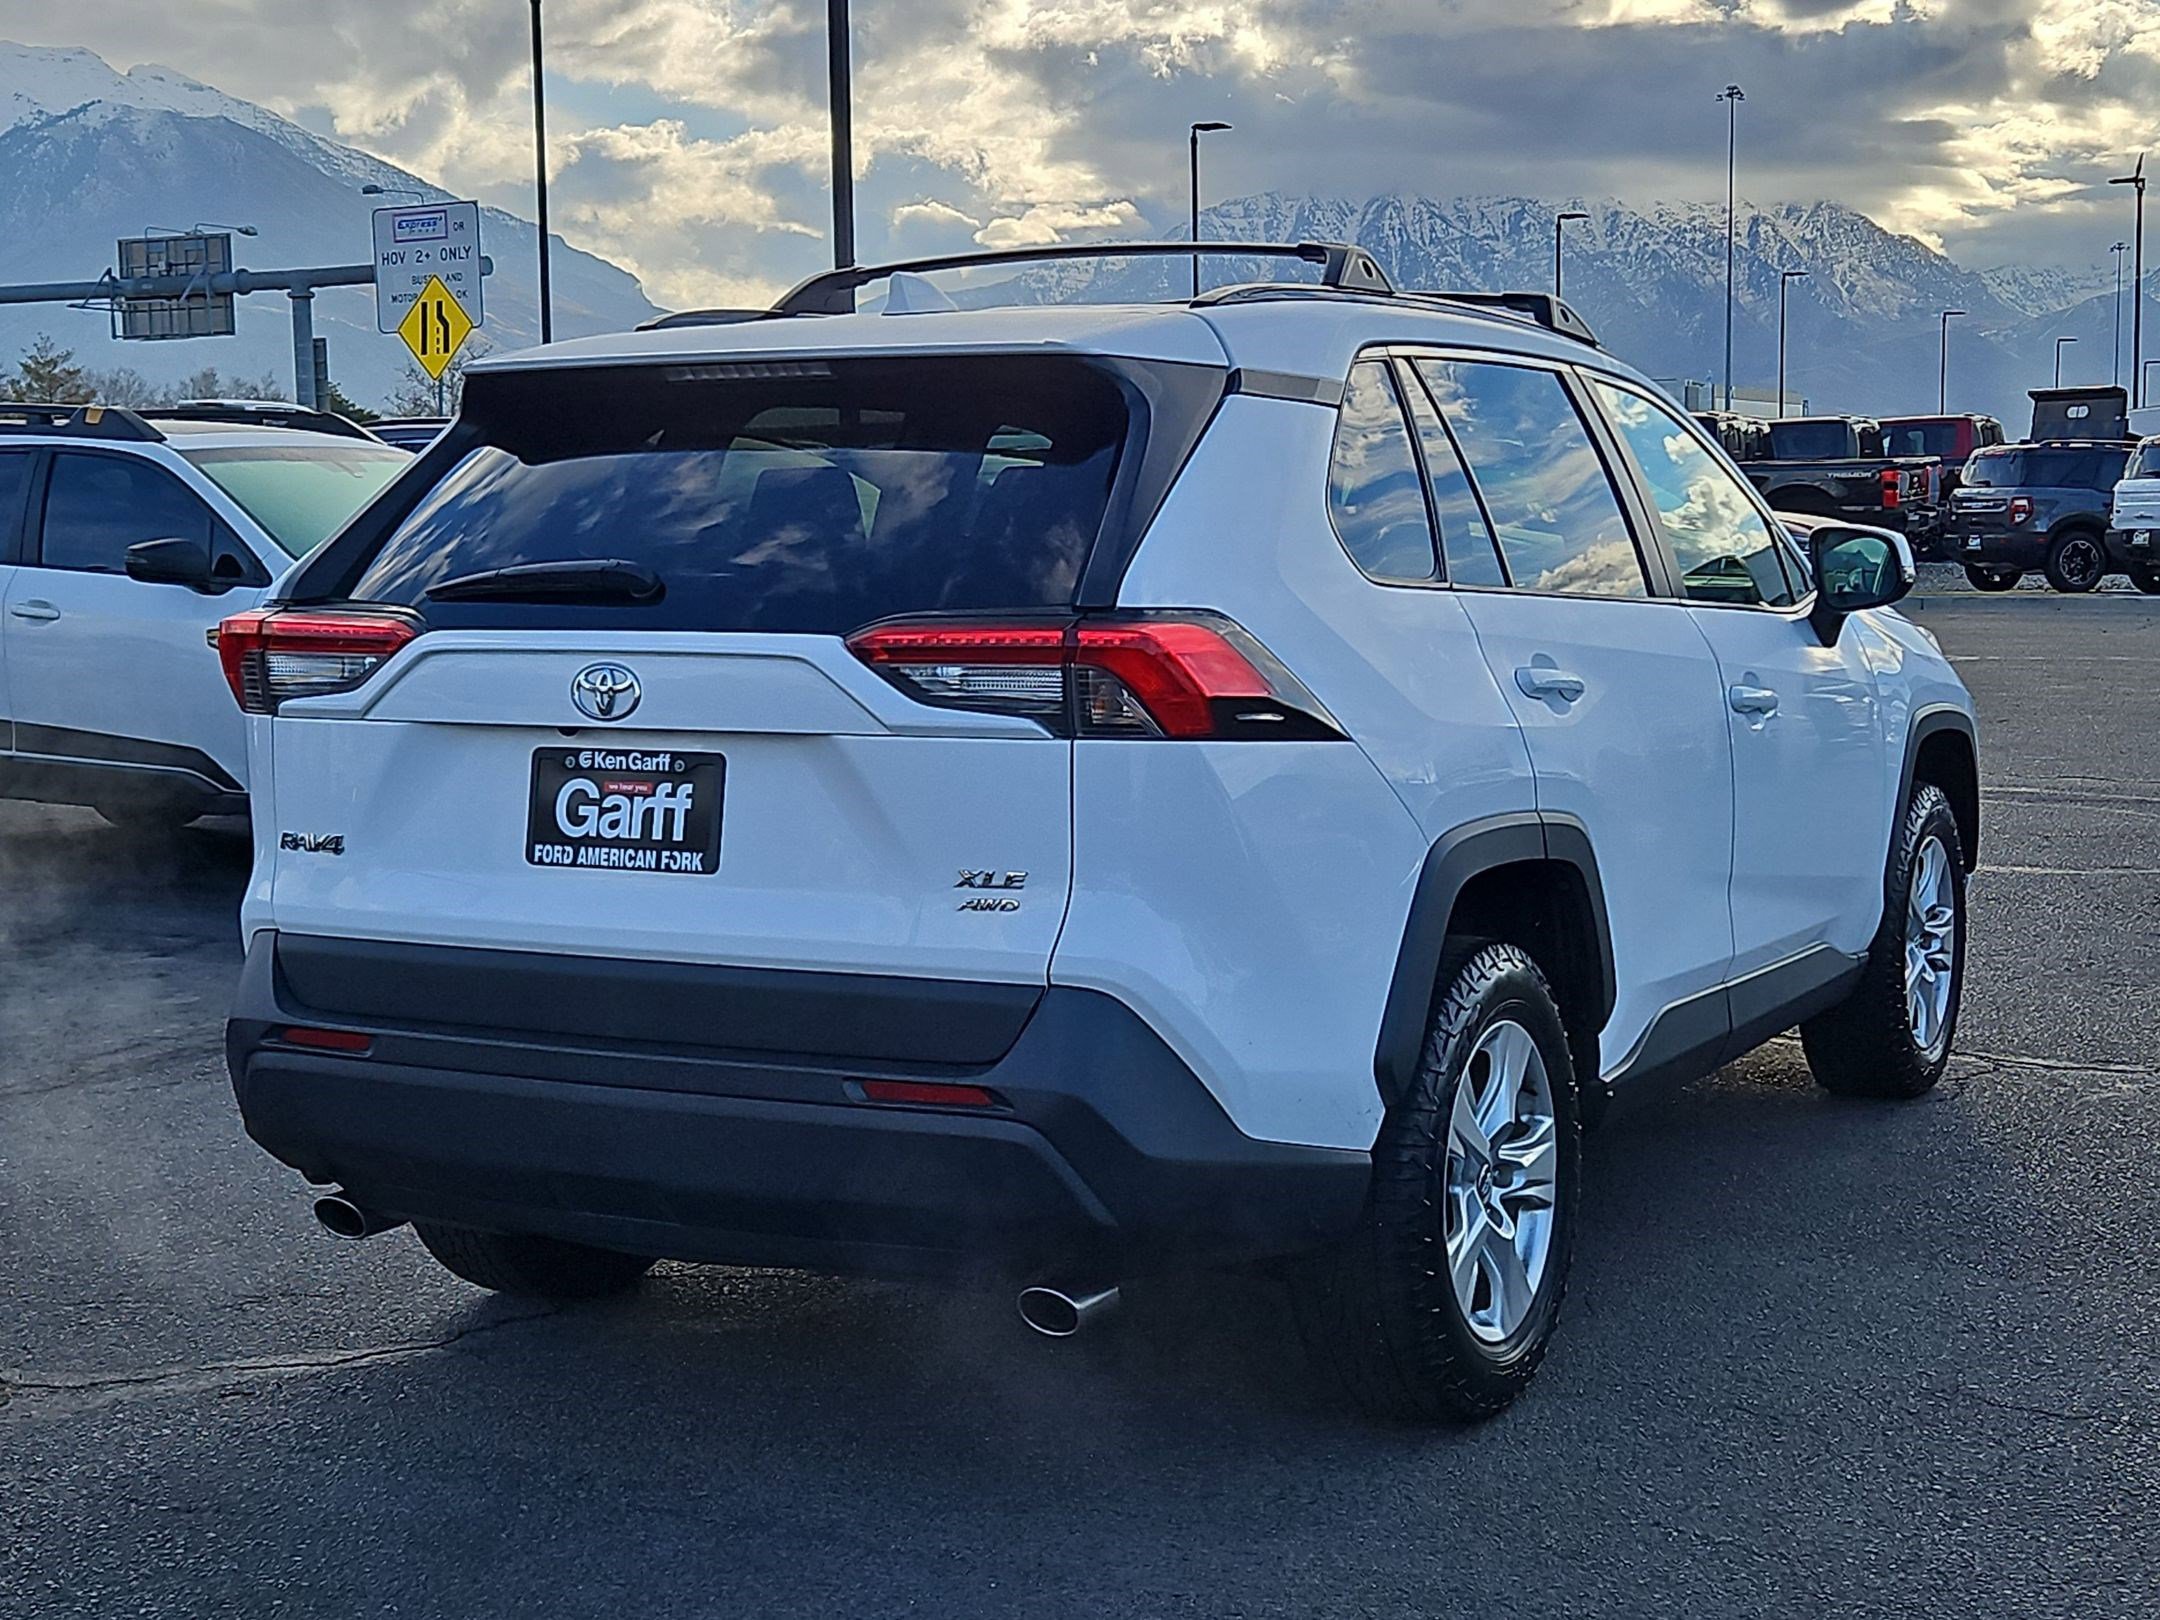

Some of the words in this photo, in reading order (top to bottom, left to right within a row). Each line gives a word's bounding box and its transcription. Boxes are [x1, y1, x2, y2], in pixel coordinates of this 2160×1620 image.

[397, 218, 437, 231] Express
[453, 221, 464, 231] OR
[381, 251, 406, 266] HOV
[415, 249, 431, 263] 2+
[440, 245, 472, 261] ONLY
[445, 272, 463, 282] AND
[456, 289, 469, 299] OK
[594, 751, 627, 769] Ken
[628, 752, 670, 771] Garff
[635, 784, 648, 793] you
[555, 777, 694, 842] Garff
[280, 832, 345, 856] RAV4
[533, 844, 574, 865] FORD
[576, 846, 657, 869] AMERICAN
[660, 850, 704, 872] FORK
[953, 869, 1029, 890] XLE
[956, 898, 1021, 912] AWD
